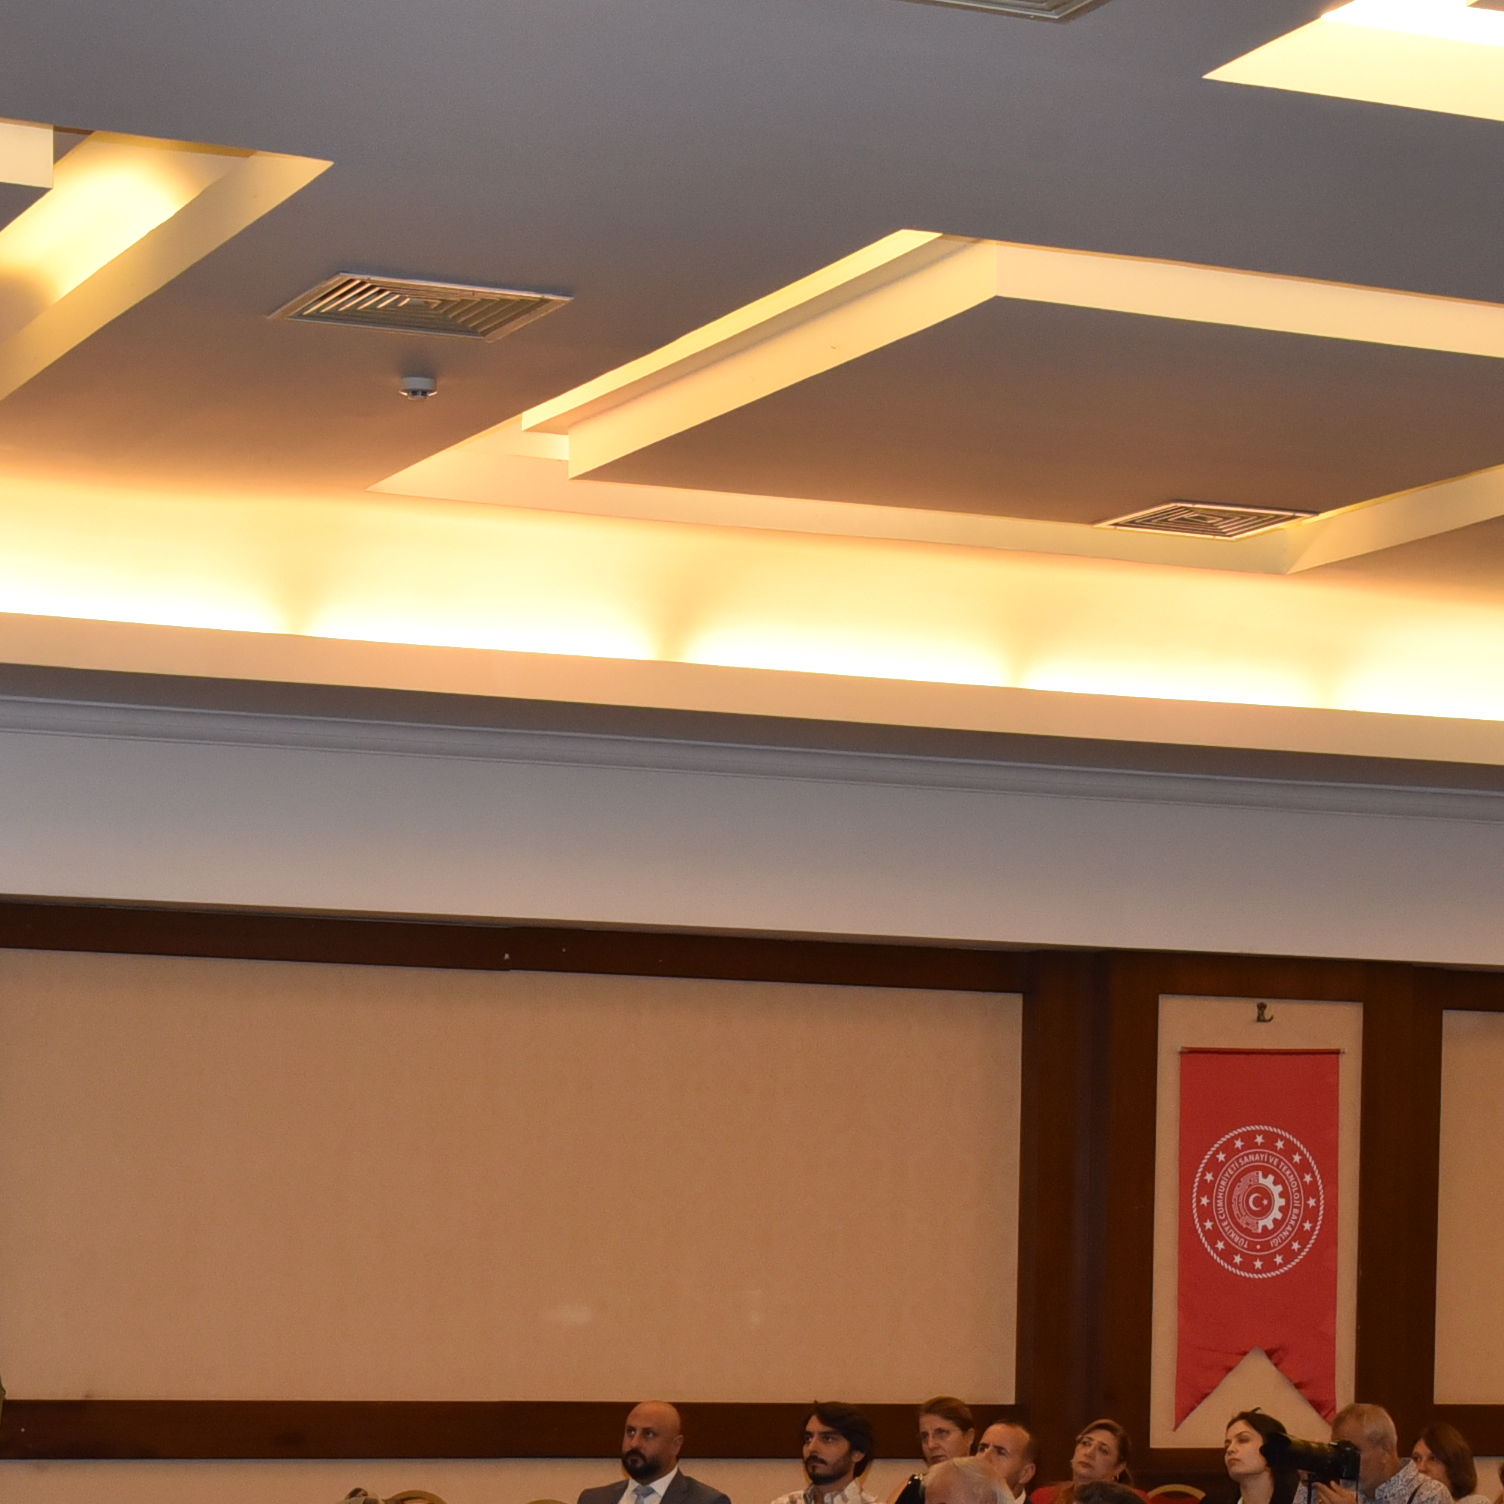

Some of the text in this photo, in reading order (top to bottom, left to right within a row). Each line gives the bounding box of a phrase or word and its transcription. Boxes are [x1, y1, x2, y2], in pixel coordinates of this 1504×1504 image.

[1216, 1153, 1302, 1248] TÜRKİYE CUMHURİYETİ SANAYİ VE TEKNOLOJİ BAKANLIĞI
